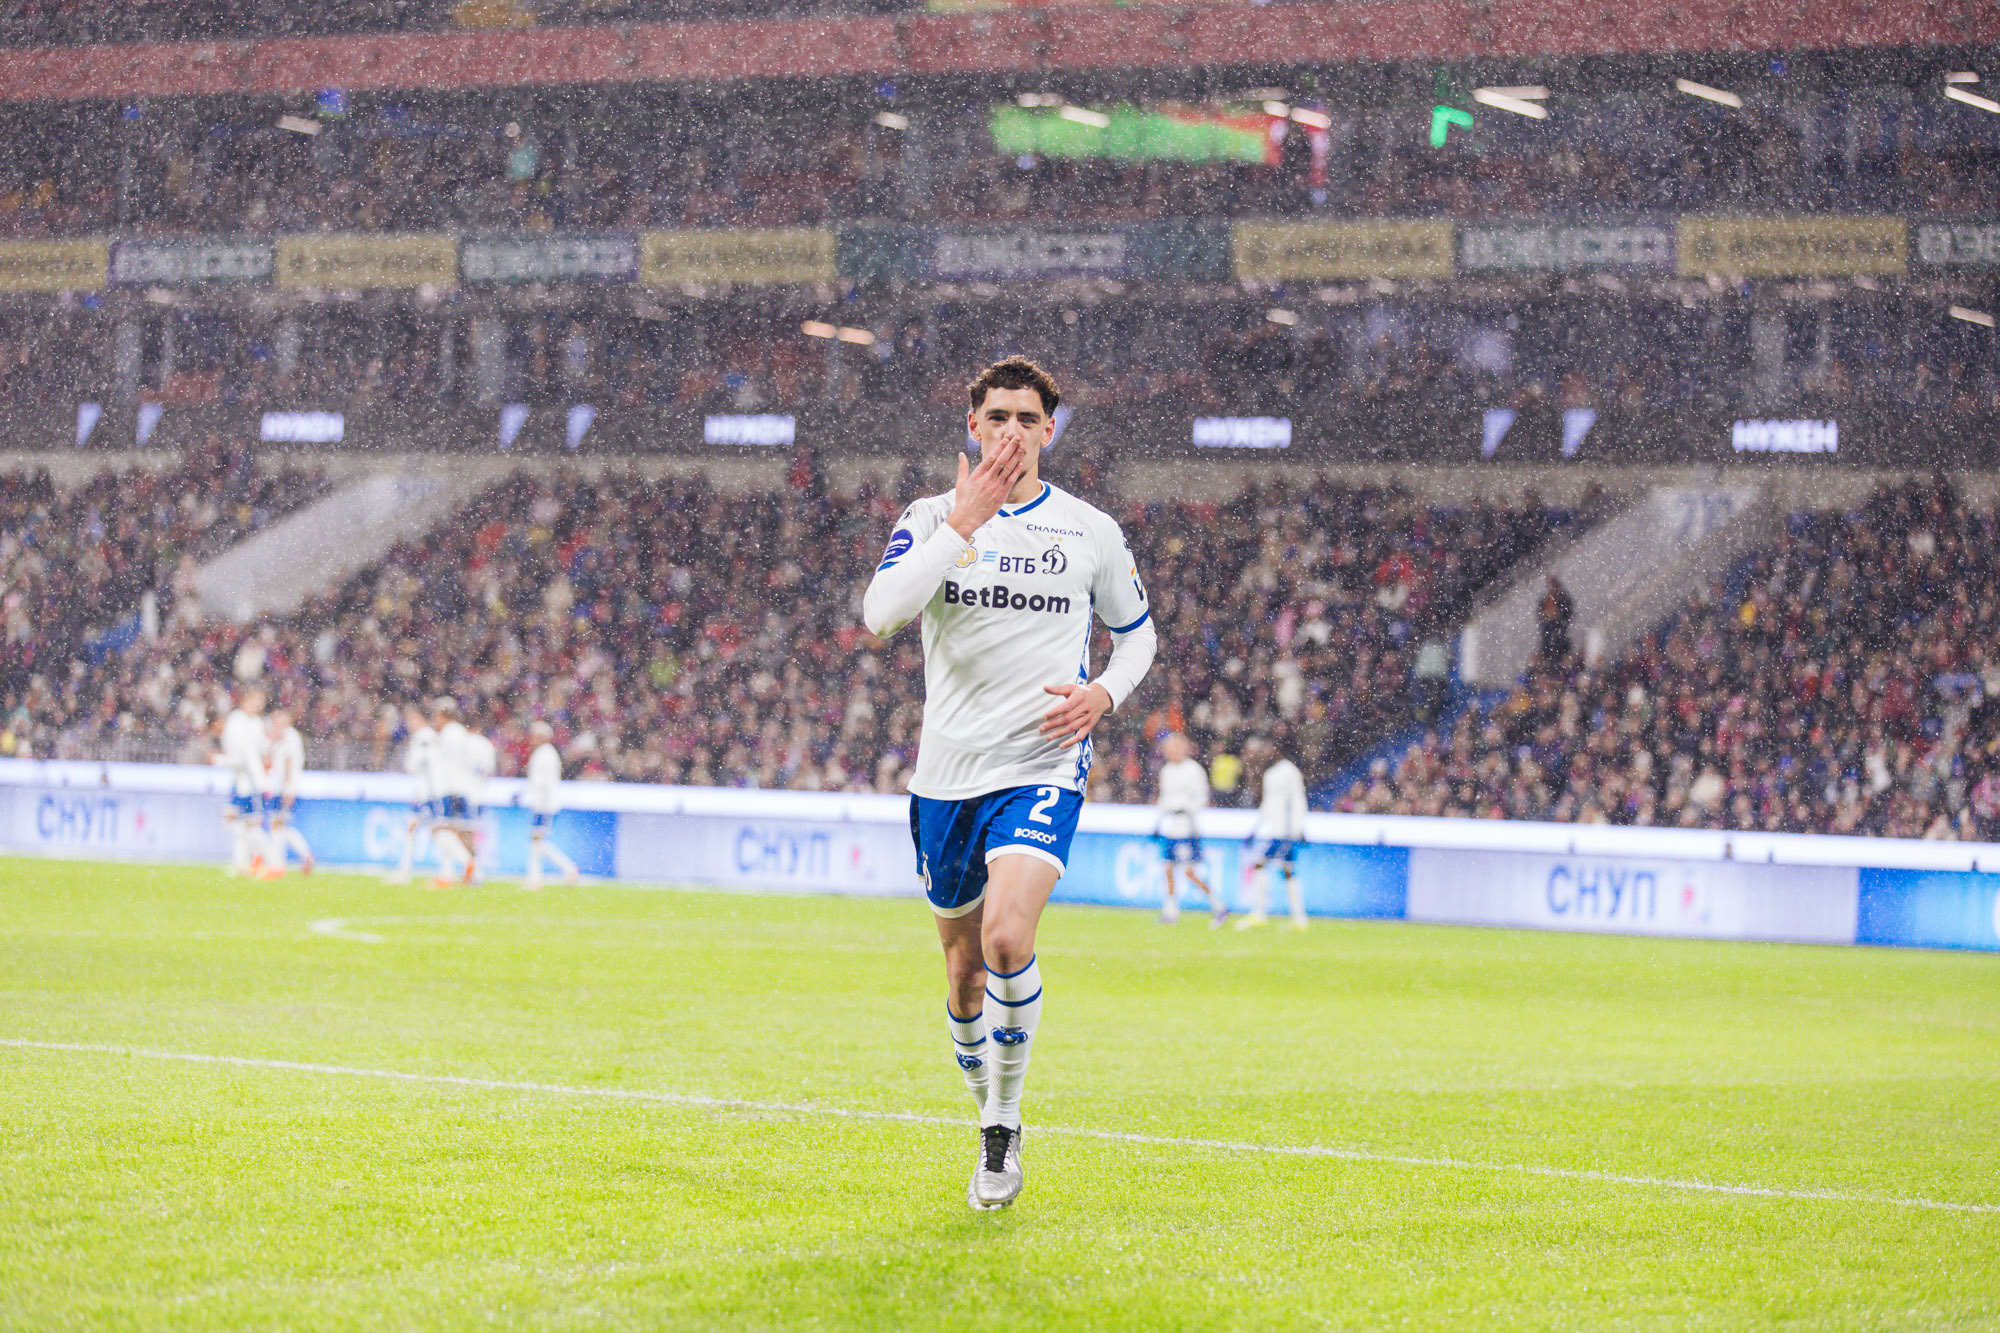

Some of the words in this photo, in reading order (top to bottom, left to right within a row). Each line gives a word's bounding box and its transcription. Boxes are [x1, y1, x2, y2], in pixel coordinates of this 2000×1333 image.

[1026, 523, 1084, 538] CHANGAN
[999, 555, 1036, 574] ВТБ
[944, 580, 1071, 614] BetBoom
[36, 793, 119, 841] СНУП
[1028, 786, 1060, 826] 2
[734, 826, 830, 877] СНУП
[1013, 827, 1053, 845] BOSCO
[1546, 864, 1656, 921] СНУП
